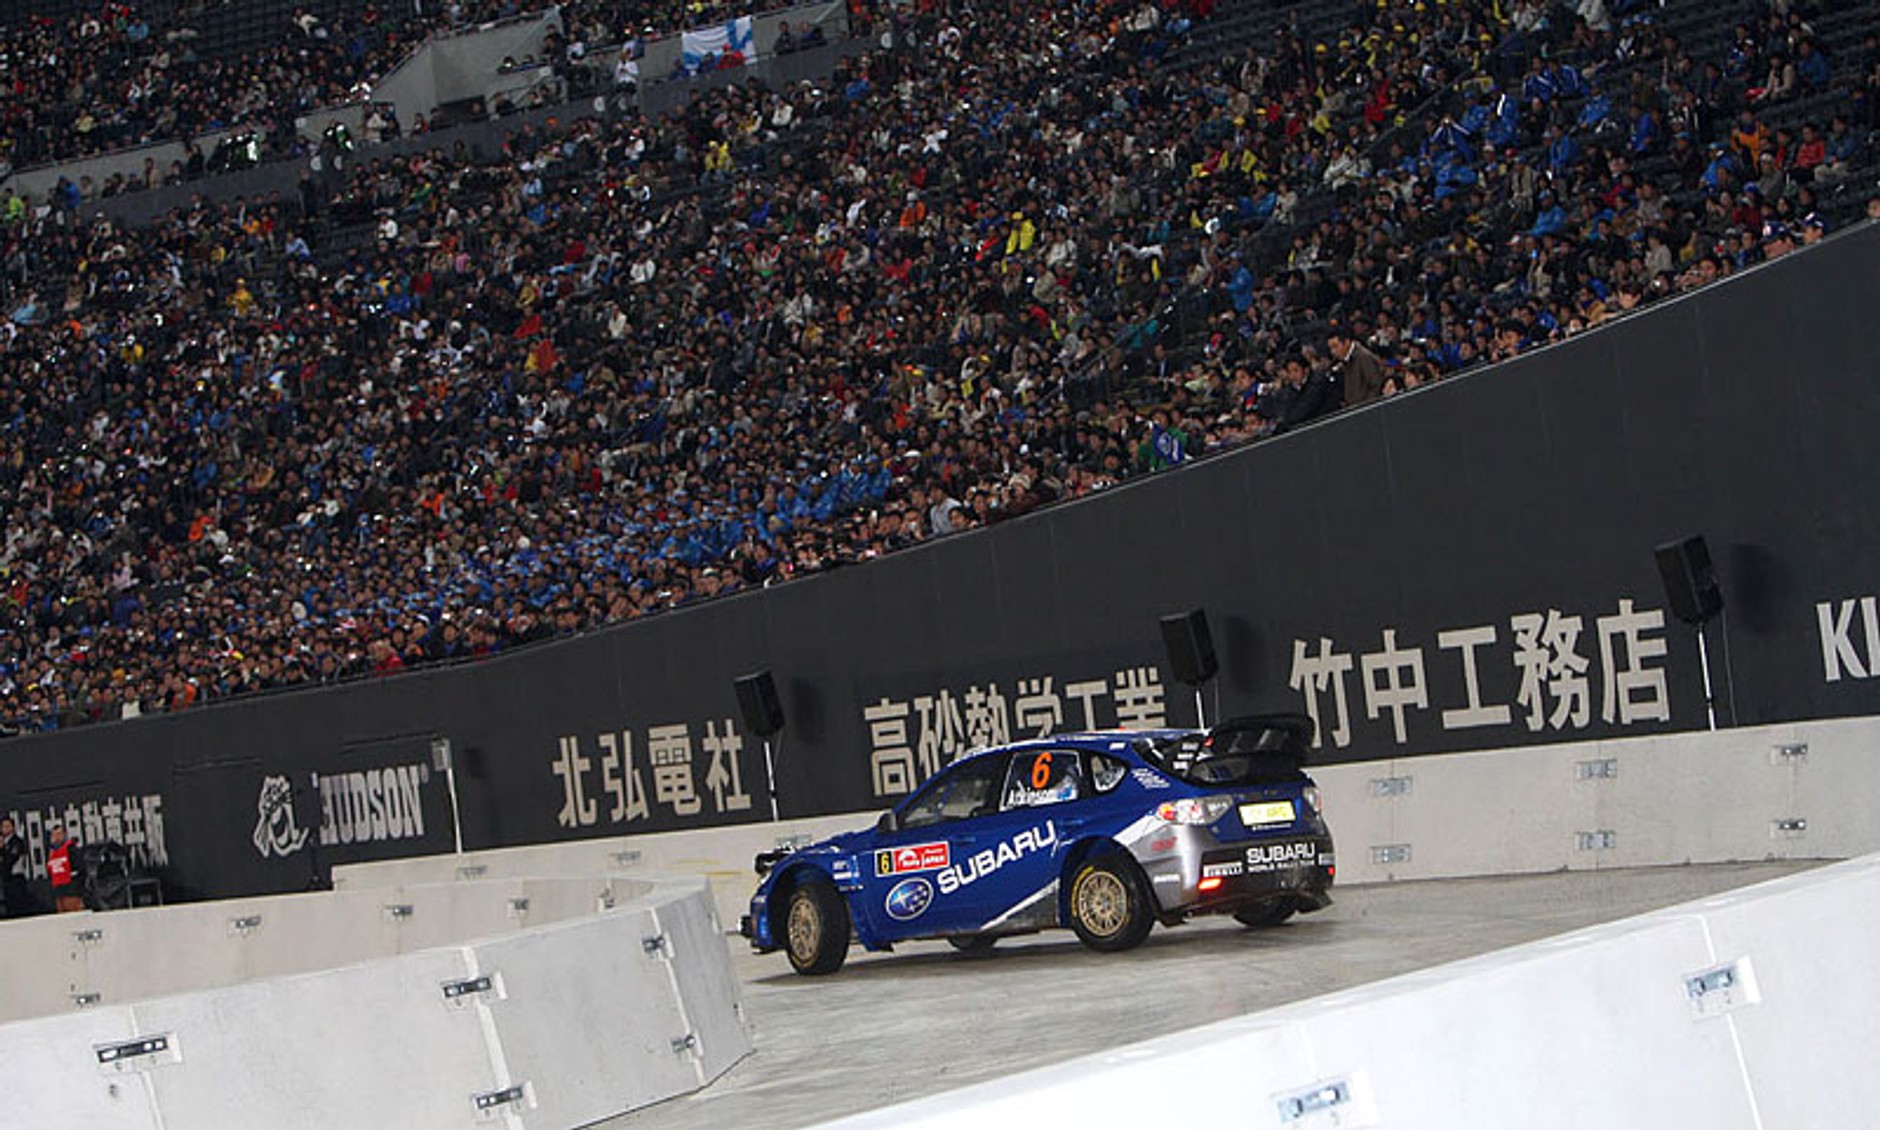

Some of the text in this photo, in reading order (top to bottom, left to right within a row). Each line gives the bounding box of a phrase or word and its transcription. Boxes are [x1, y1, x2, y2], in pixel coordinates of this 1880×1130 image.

[1290, 599, 1671, 749] 竹中工務店
[552, 718, 751, 828] 北弘電社
[1031, 751, 1053, 790] 6
[881, 853, 890, 874] 6
[937, 819, 1056, 894] SUBARU
[1246, 842, 1316, 864] SUBARU
